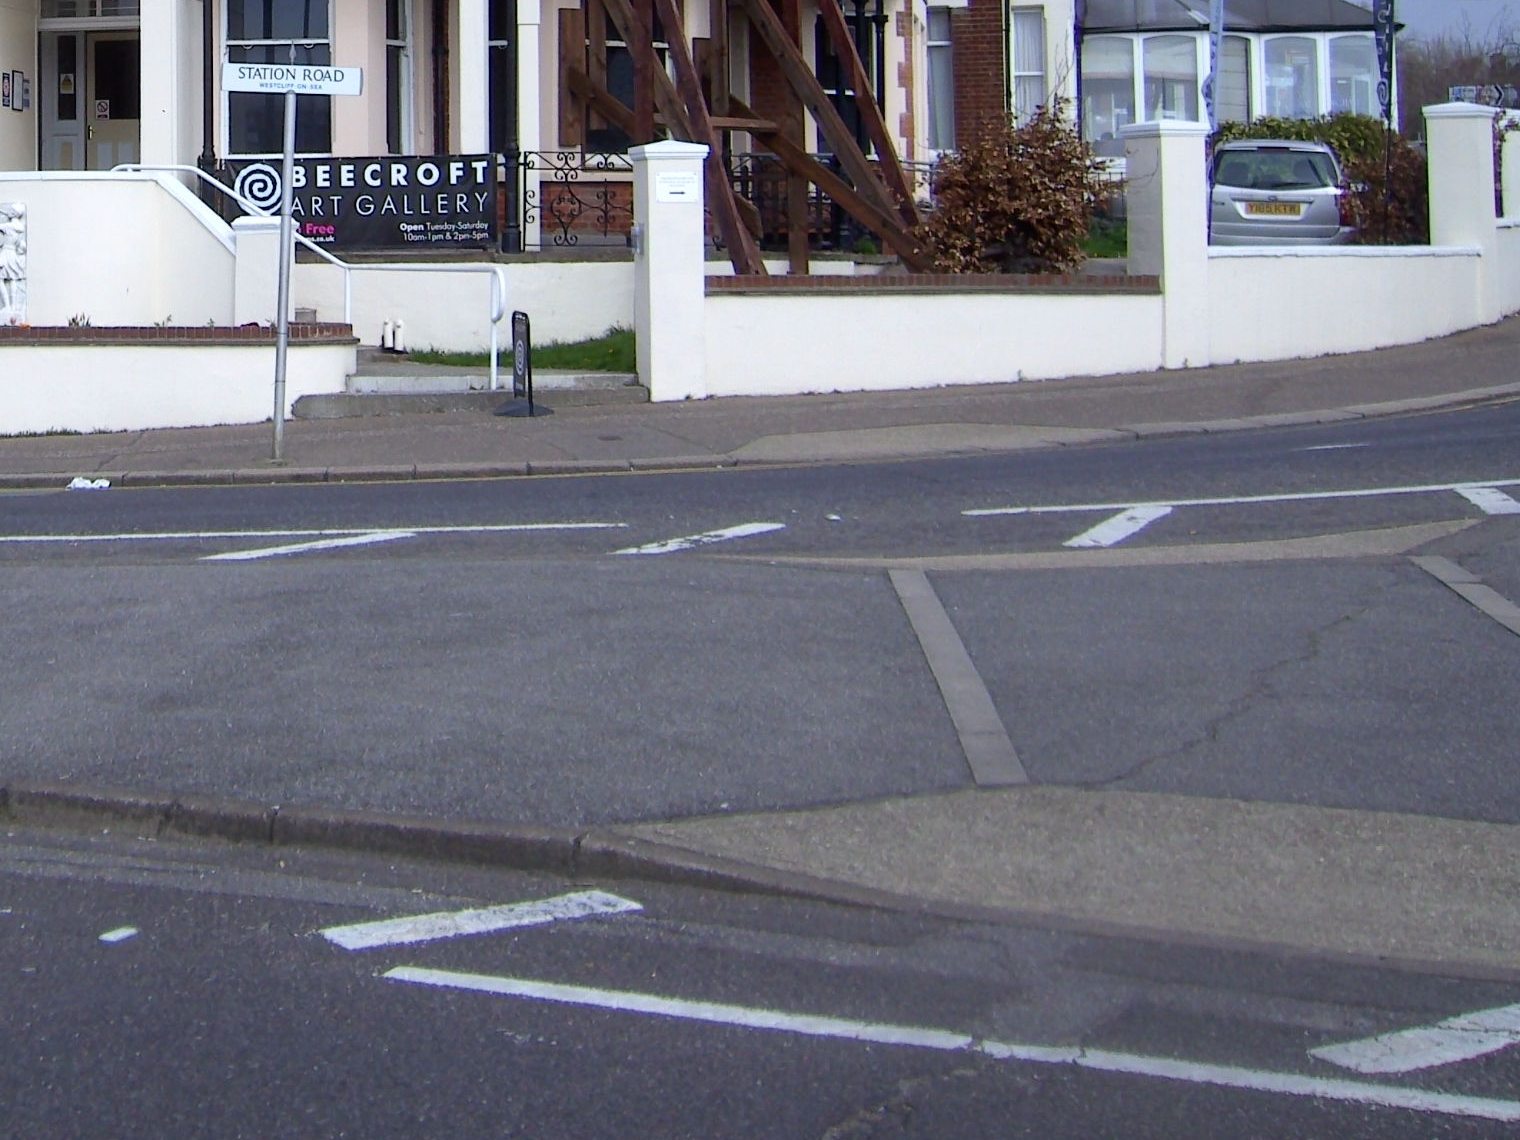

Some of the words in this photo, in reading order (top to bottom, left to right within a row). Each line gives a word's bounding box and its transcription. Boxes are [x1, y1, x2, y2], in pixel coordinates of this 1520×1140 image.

[238, 66, 297, 80] STATION
[303, 68, 345, 83] ROAD
[292, 161, 488, 188] BEECROFT
[292, 195, 343, 217] ART
[356, 192, 488, 216] GALLERY
[306, 222, 335, 235] Free
[399, 222, 424, 232] Open
[403, 232, 443, 242] 10am-1pm
[445, 232, 452, 240] &
[453, 230, 489, 241] 2pm-5pm
